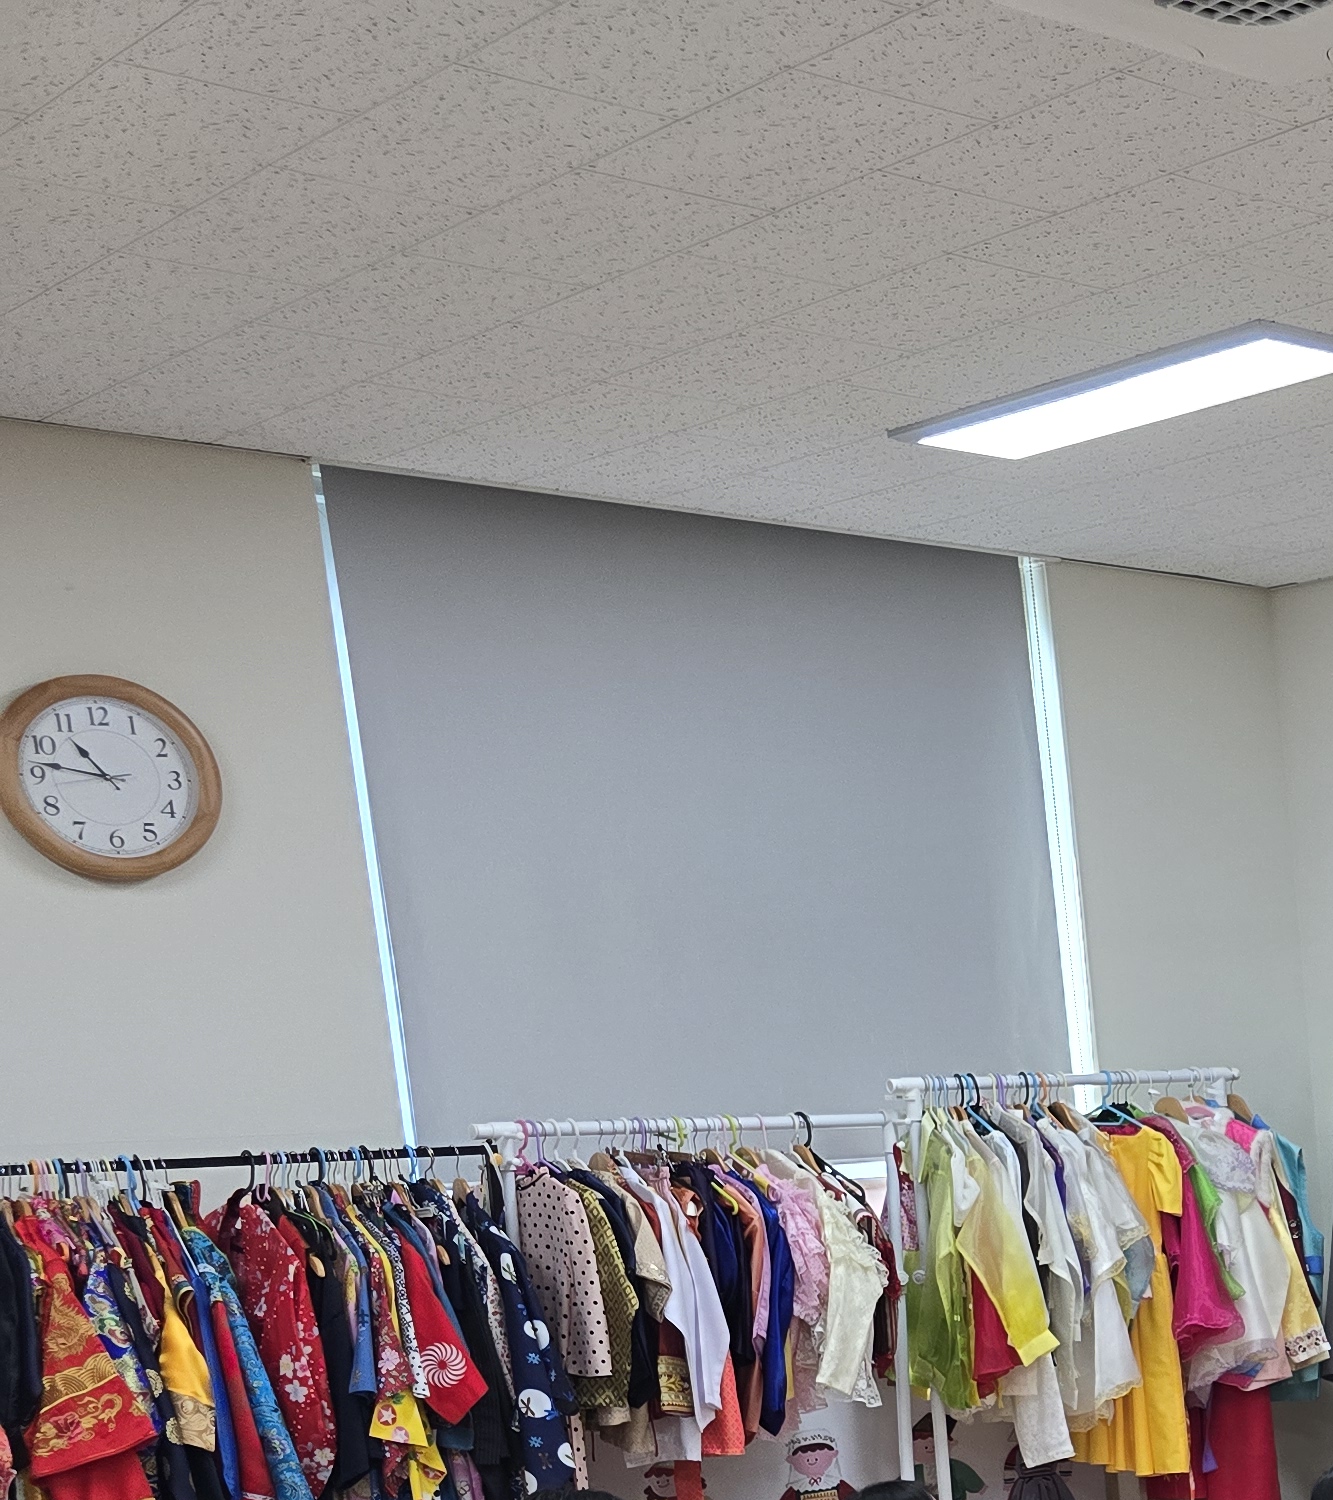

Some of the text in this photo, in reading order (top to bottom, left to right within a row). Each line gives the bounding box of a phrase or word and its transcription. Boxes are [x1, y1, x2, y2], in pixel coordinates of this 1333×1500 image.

[54, 713, 74, 733] 11
[87, 706, 110, 726] 12
[127, 715, 137, 735] 1
[31, 735, 56, 755] 10
[154, 738, 168, 757] 2
[30, 765, 46, 785] 9
[167, 771, 182, 790] 3
[43, 795, 60, 816] 8
[160, 800, 177, 819] 4
[72, 821, 86, 840] 7
[109, 829, 125, 848] 6
[143, 823, 158, 842] 5
